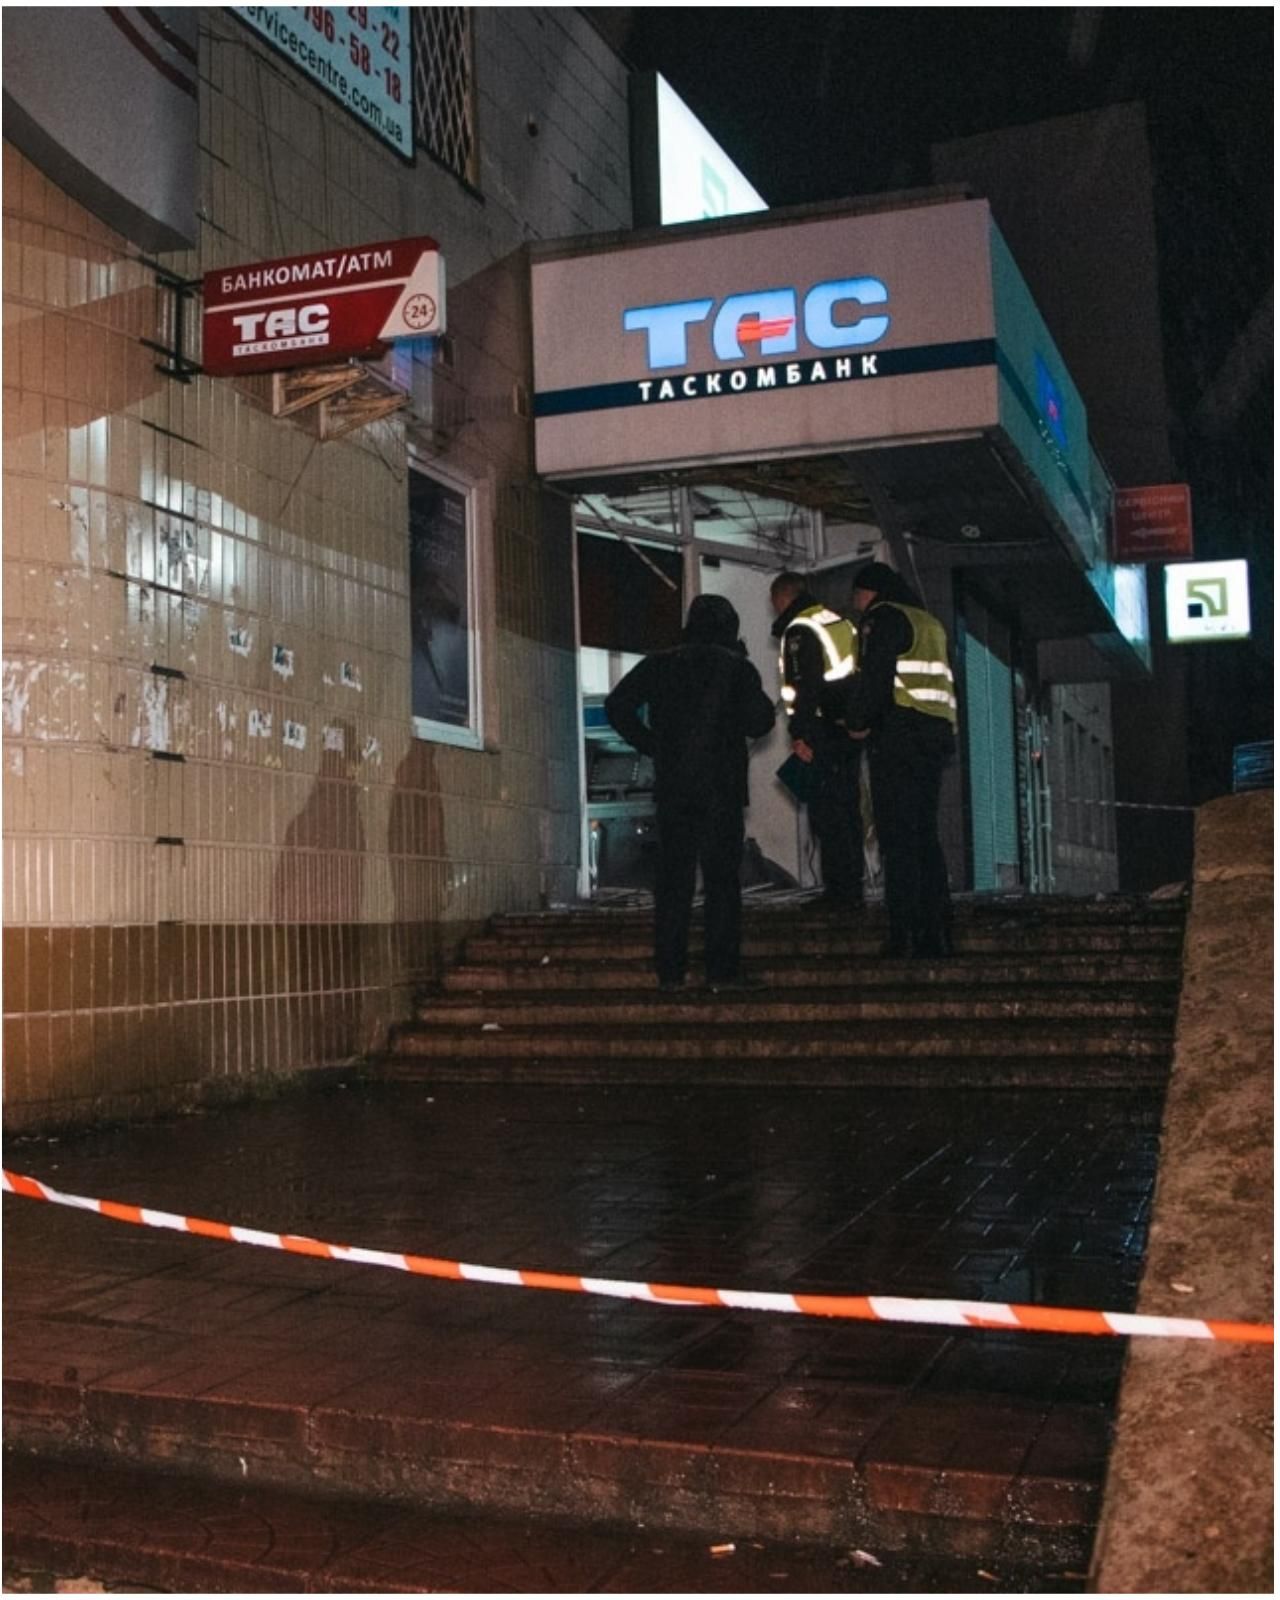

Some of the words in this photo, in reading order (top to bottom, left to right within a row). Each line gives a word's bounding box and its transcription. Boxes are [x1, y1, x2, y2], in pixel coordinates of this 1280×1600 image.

[239, 6, 403, 143] ervicecentre.com.ua
[350, 32, 370, 76] 58
[385, 67, 402, 105] 18
[409, 305, 428, 319] 24
[624, 275, 890, 370] ТАС
[237, 335, 325, 355] ТАСКОМБАНК
[638, 354, 879, 402] ТАСКОМБАНК
